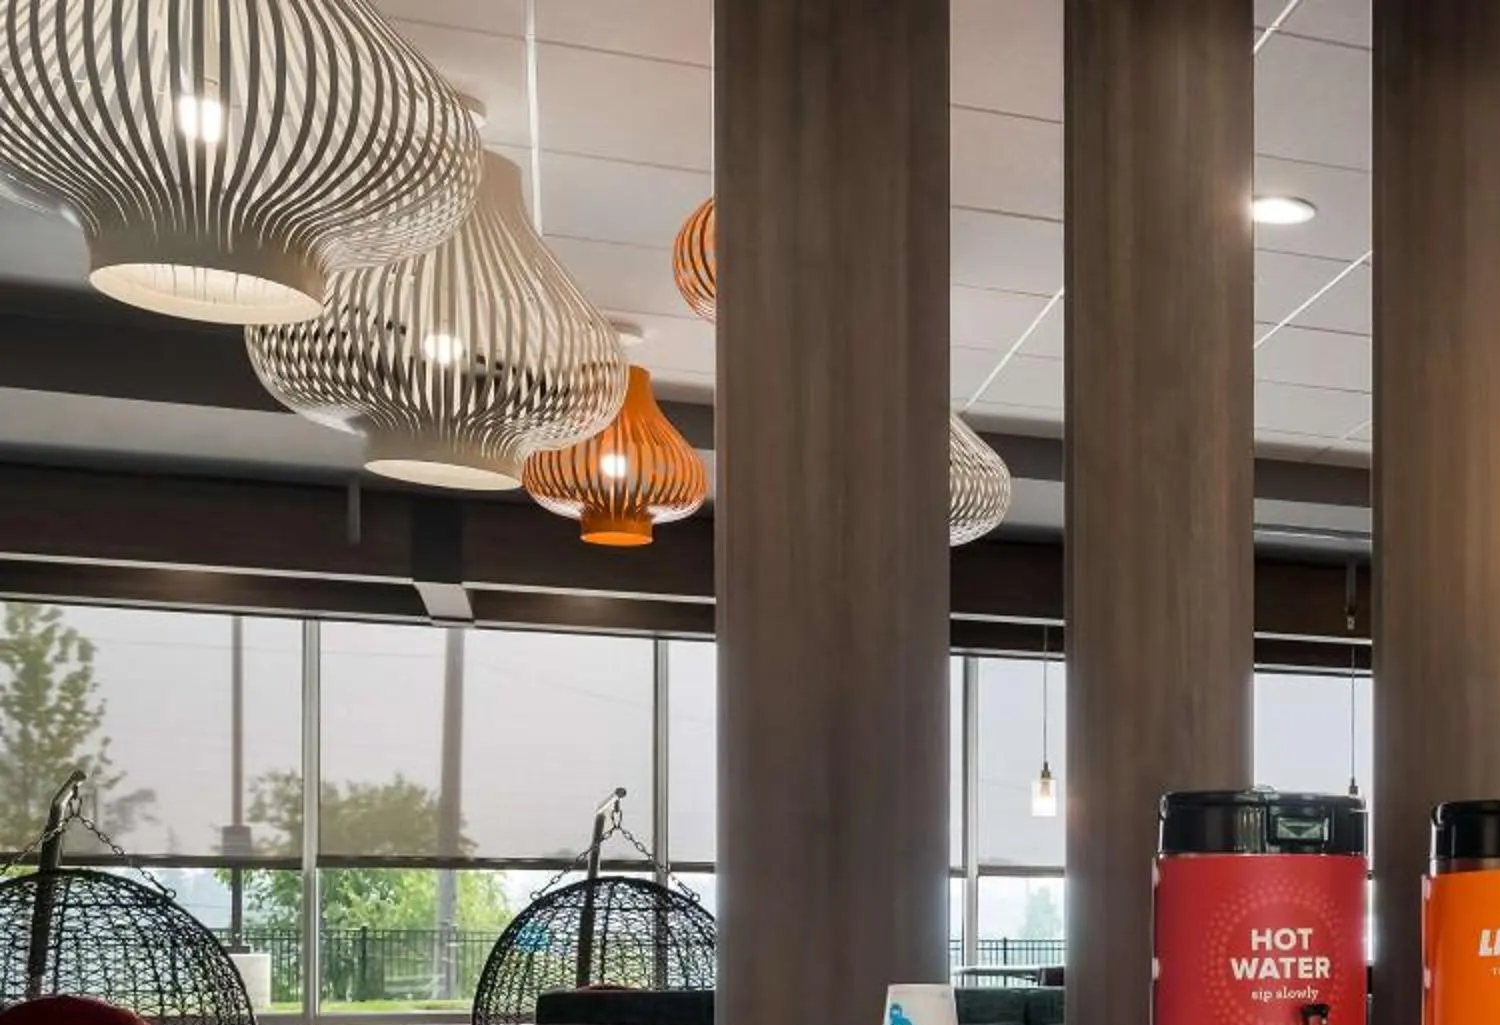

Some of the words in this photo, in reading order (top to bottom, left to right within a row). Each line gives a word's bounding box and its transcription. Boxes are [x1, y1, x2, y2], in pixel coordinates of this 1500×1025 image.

[1251, 928, 1313, 951] HOT
[1231, 957, 1331, 980] WATER
[1251, 987, 1273, 1003] sip
[1275, 985, 1319, 1002] slowly
